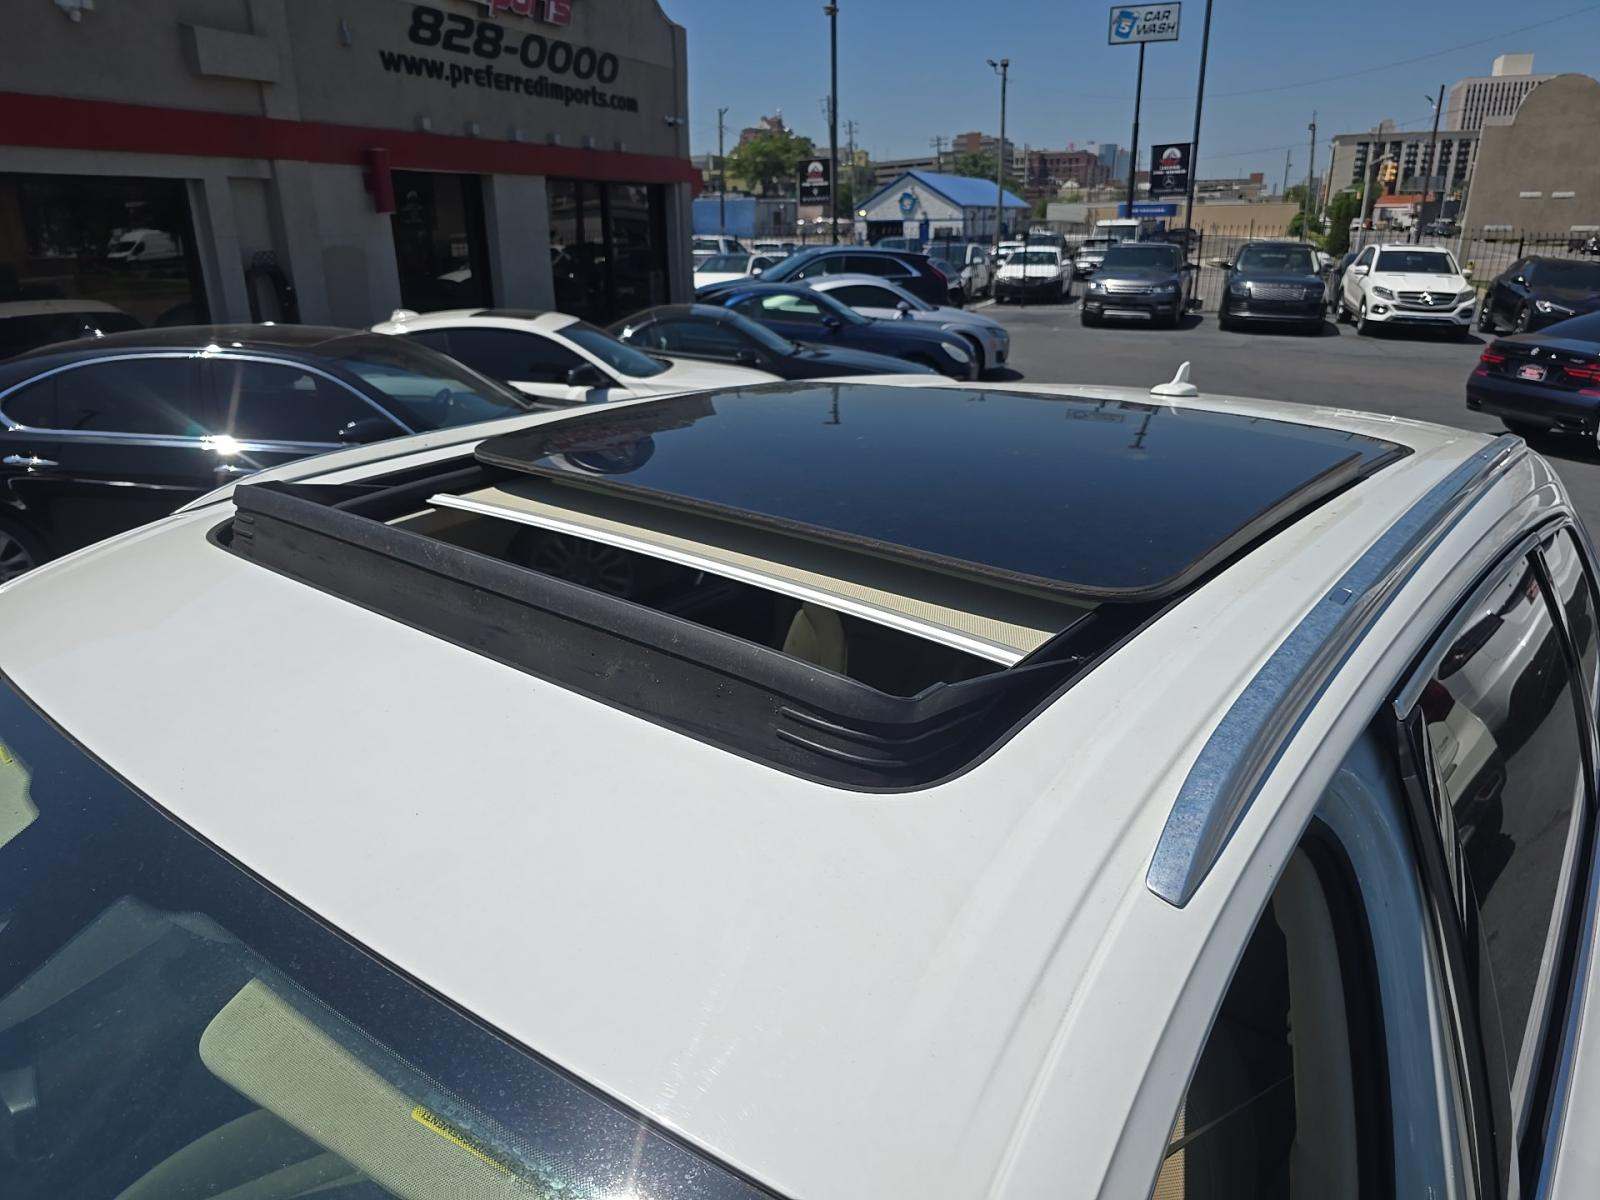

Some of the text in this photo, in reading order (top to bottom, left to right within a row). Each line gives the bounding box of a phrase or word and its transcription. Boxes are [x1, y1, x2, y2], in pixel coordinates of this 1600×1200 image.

[1136, 22, 1176, 35] WASH
[1143, 10, 1171, 22] CAR
[408, 5, 619, 84] 828-0000
[379, 49, 639, 113] www.preferredimports.com
